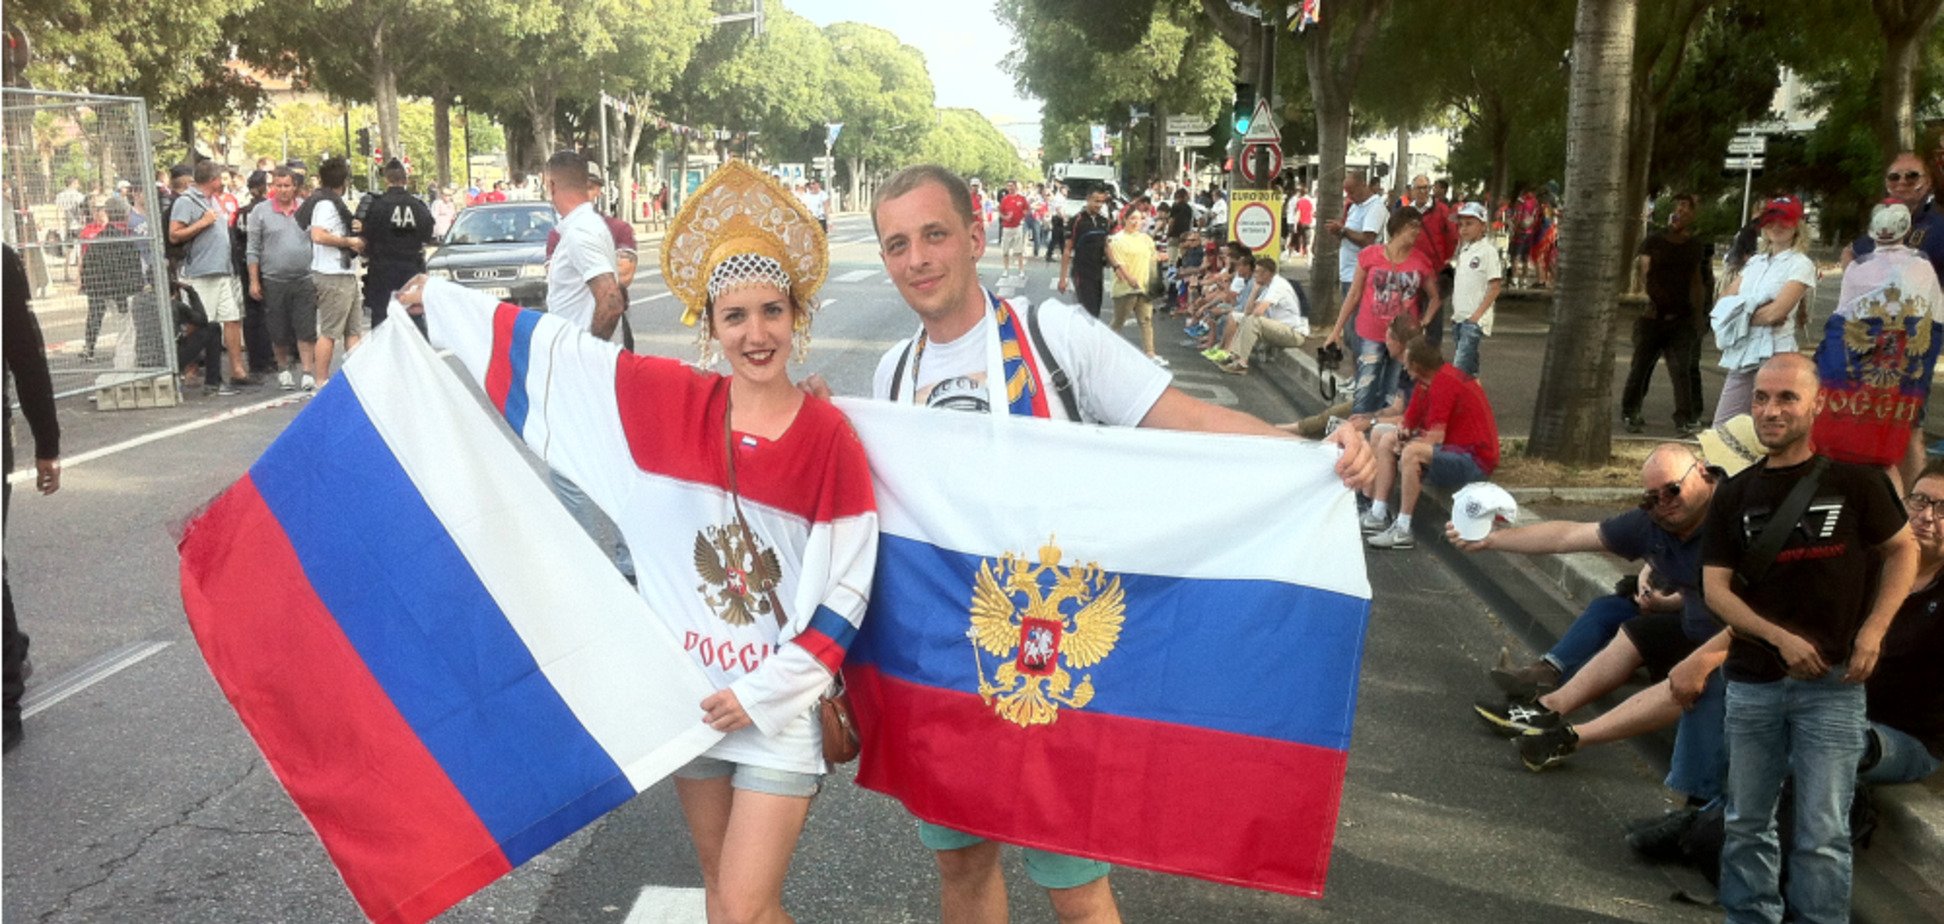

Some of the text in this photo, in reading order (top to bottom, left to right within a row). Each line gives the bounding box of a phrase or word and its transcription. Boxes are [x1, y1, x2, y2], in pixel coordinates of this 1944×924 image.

[1232, 192, 1257, 201] EURO
[390, 205, 416, 228] 4A
[1815, 388, 1917, 421] ОССИ
[683, 630, 780, 674] РОСС
